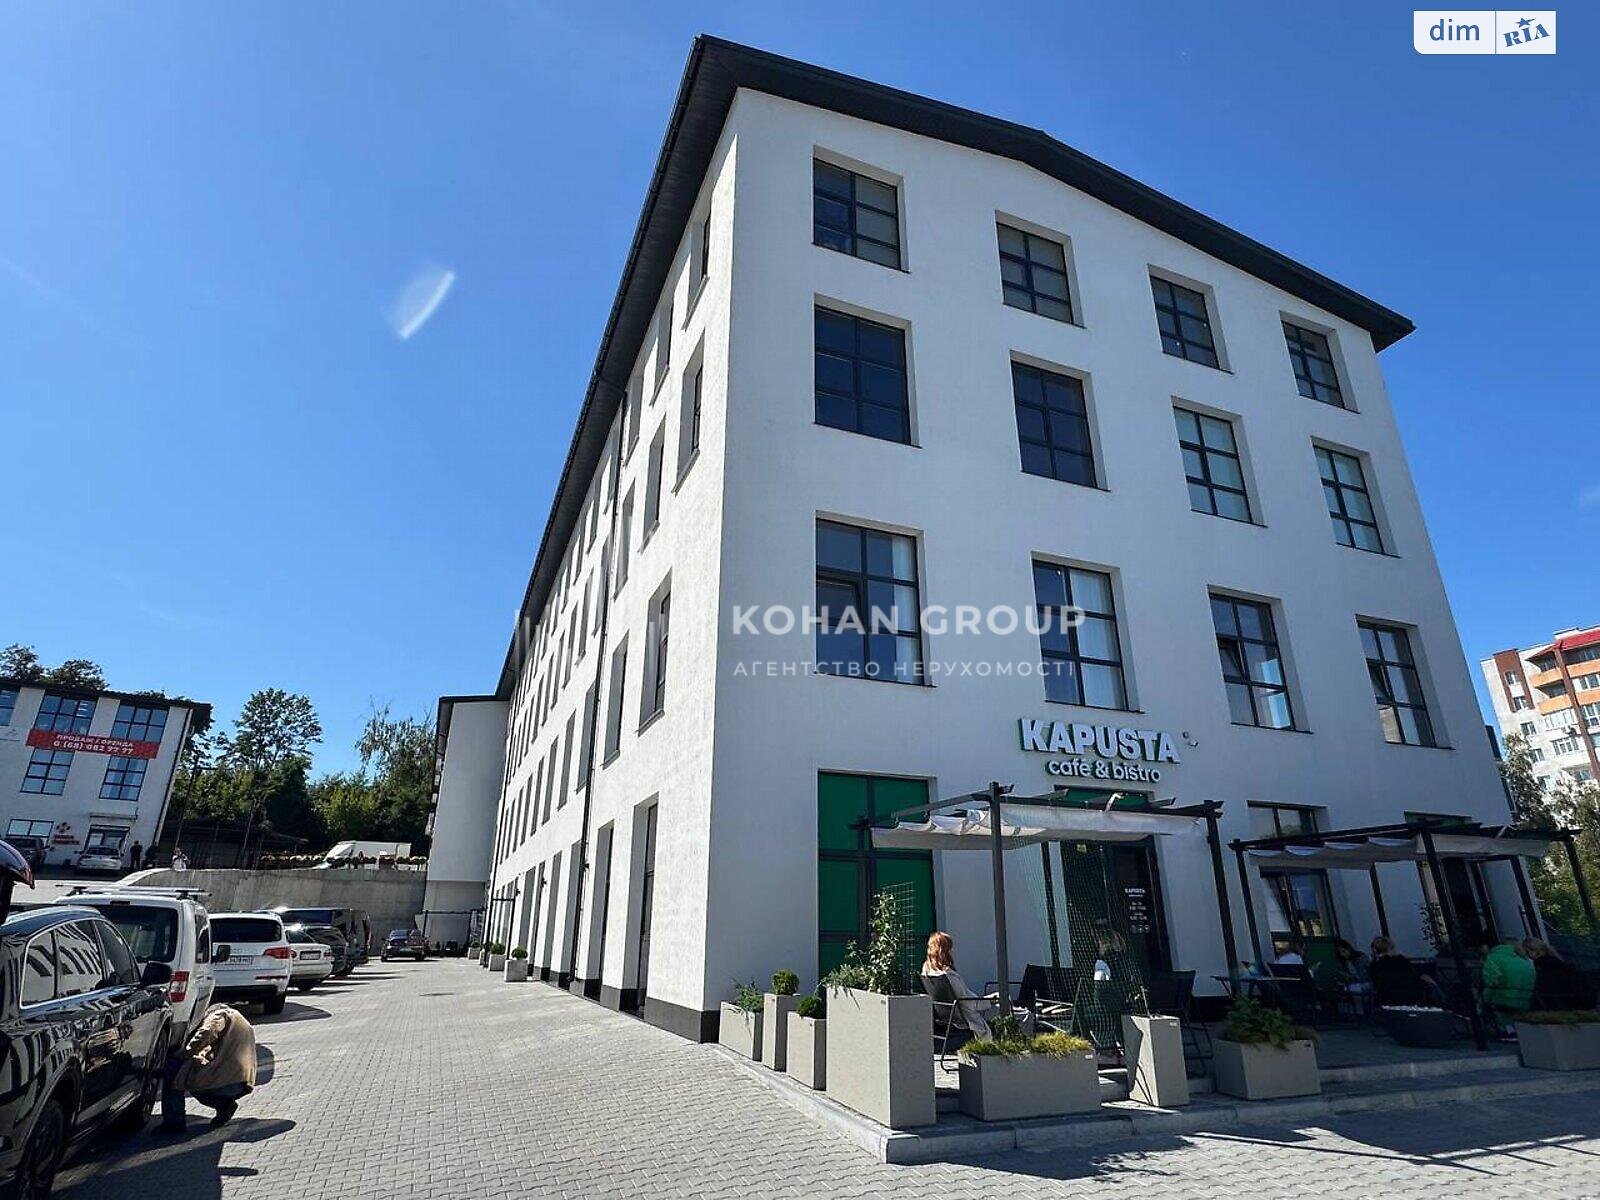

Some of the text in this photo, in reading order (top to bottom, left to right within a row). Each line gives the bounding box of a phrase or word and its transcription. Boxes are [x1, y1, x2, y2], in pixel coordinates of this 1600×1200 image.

[1019, 718, 1181, 764] KAPUSTA
[1095, 759, 1112, 779] &
[1112, 760, 1161, 783] bistro
